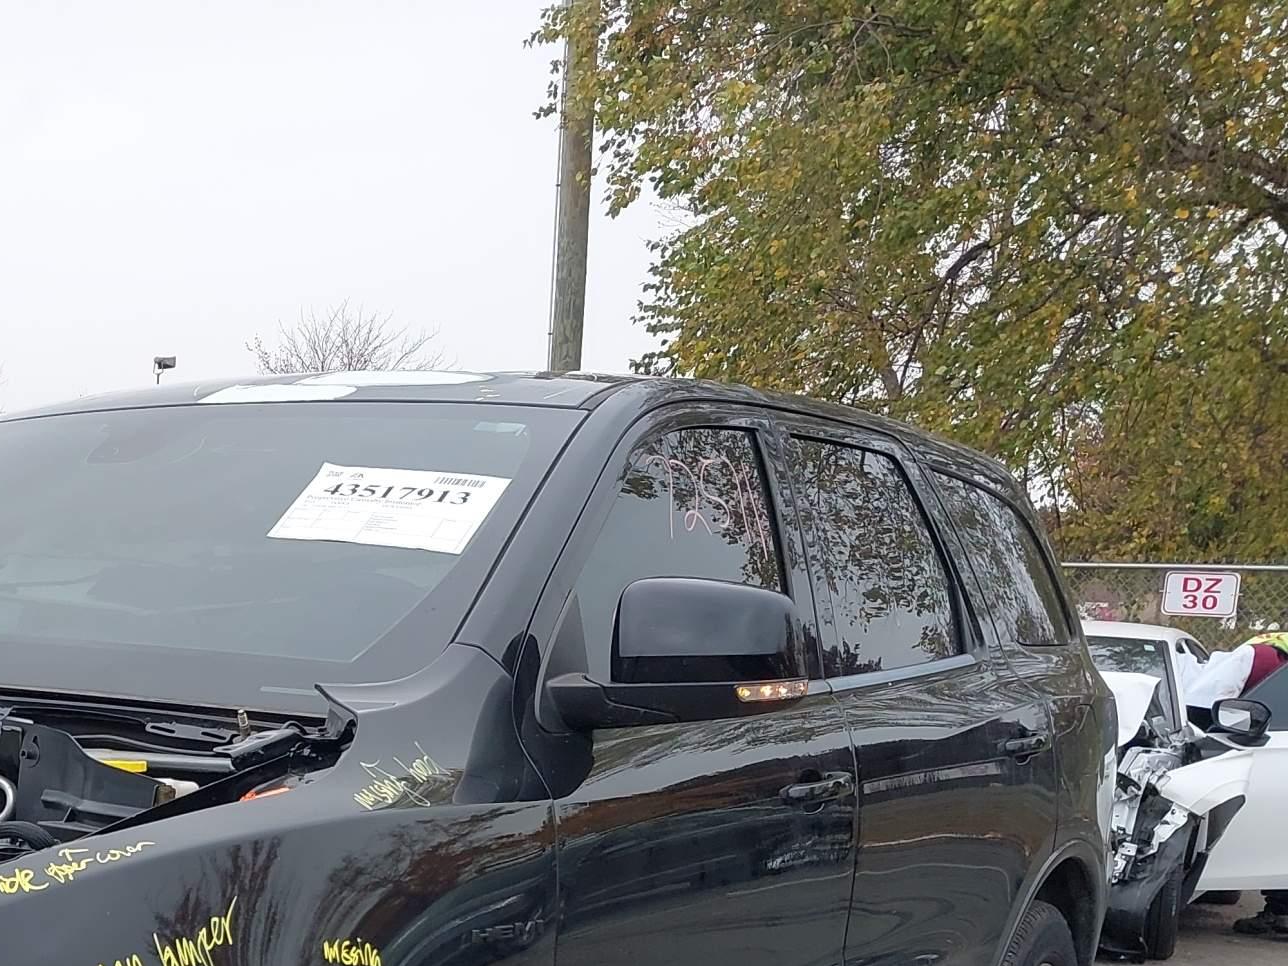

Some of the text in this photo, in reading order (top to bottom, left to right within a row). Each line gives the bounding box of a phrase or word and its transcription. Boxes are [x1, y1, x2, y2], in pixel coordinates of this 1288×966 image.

[323, 481, 472, 505] 43517913
[1182, 577, 1223, 593] DZ
[1182, 594, 1218, 610] 30
